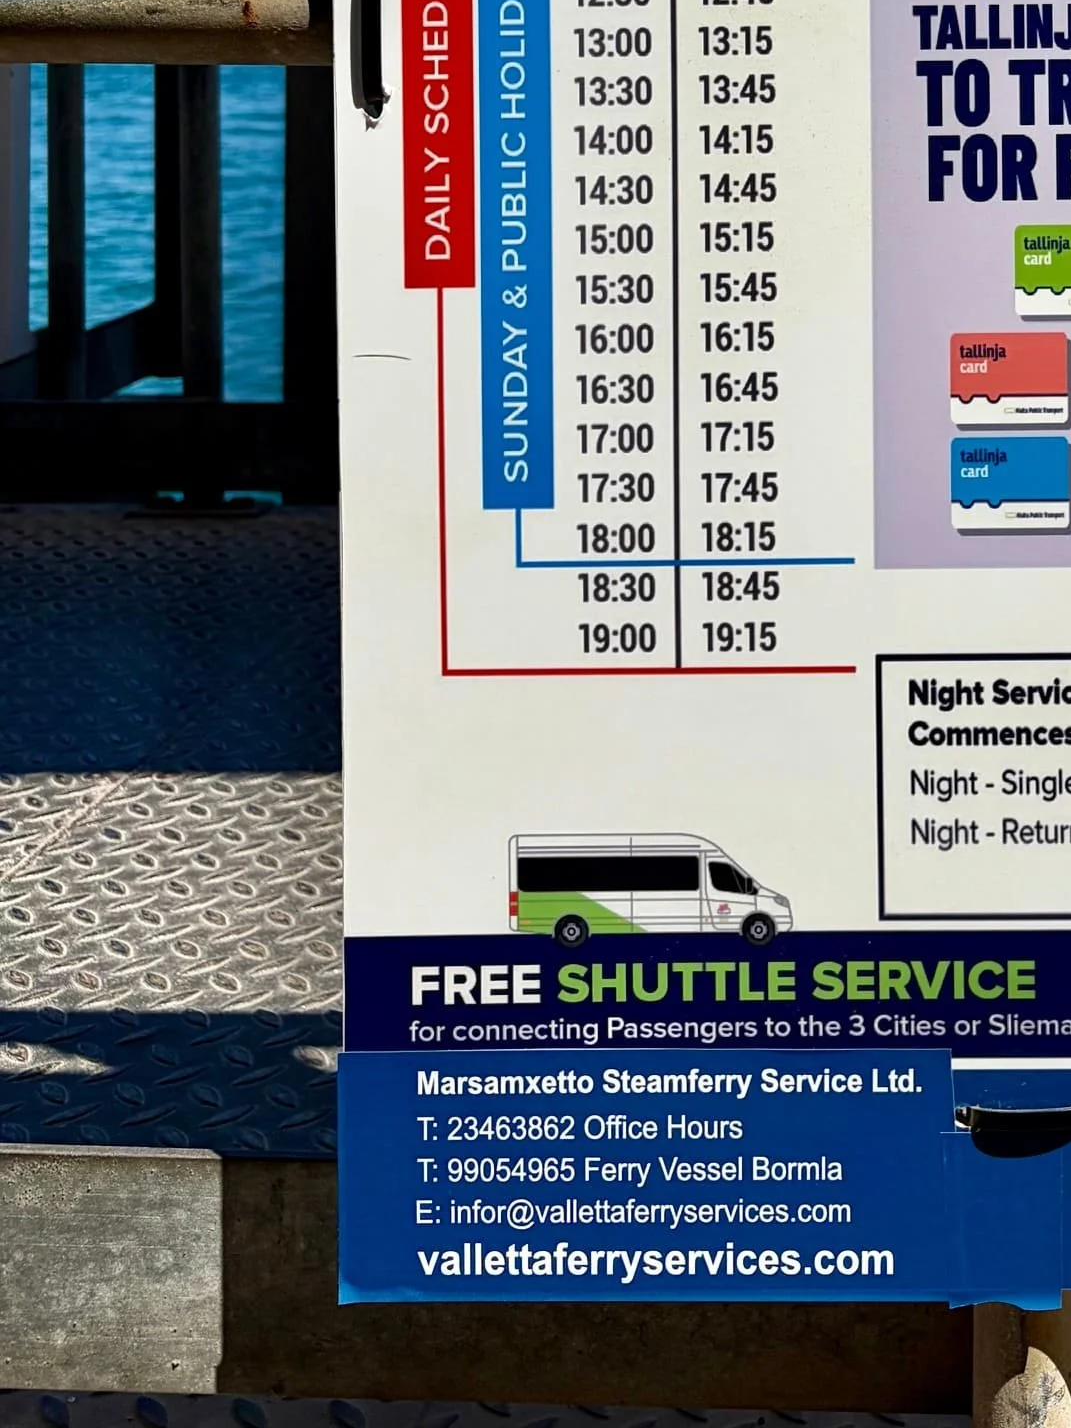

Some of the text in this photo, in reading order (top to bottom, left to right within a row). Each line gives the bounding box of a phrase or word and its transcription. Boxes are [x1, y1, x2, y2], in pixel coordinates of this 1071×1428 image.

[915, 58, 991, 128] TO
[927, 133, 1039, 203] FOR
[423, 147, 451, 261] DAILY
[500, 131, 527, 272] PUBLIC
[575, 172, 777, 206] 14:30 14:45
[1024, 236, 1071, 254] tallinja
[1024, 252, 1052, 266] card
[502, 284, 528, 309] &
[959, 344, 1007, 362] tallinja
[960, 359, 988, 373] card
[502, 320, 529, 482] SUNDAY
[576, 371, 779, 405] 16:30 16:45
[960, 448, 1008, 466] tallinja
[961, 464, 989, 478] card
[578, 621, 777, 654] 19:00 19:15
[908, 678, 985, 712] Night
[910, 769, 979, 803] Night
[911, 818, 980, 852] Night
[411, 960, 1035, 1006] FREE SHUTTLE SERVICE
[408, 1020, 446, 1042] for
[452, 1017, 599, 1046] connecting
[607, 1016, 758, 1044] Passengers
[764, 1017, 791, 1037] to
[797, 1014, 841, 1037] the
[849, 1014, 866, 1037] 3
[873, 1014, 946, 1036] Cities
[954, 1019, 982, 1036] or
[417, 1068, 922, 1100] Marsamxetto Steamferry Service Ltd.
[416, 1114, 743, 1141] T: 23463862 Office Hours
[416, 1155, 843, 1188] T: 99054965 Ferry Vessel Bormla
[416, 1198, 851, 1230] E: infor@vallettaferryservices.com
[417, 1242, 894, 1284] vallettaferryservices.com
